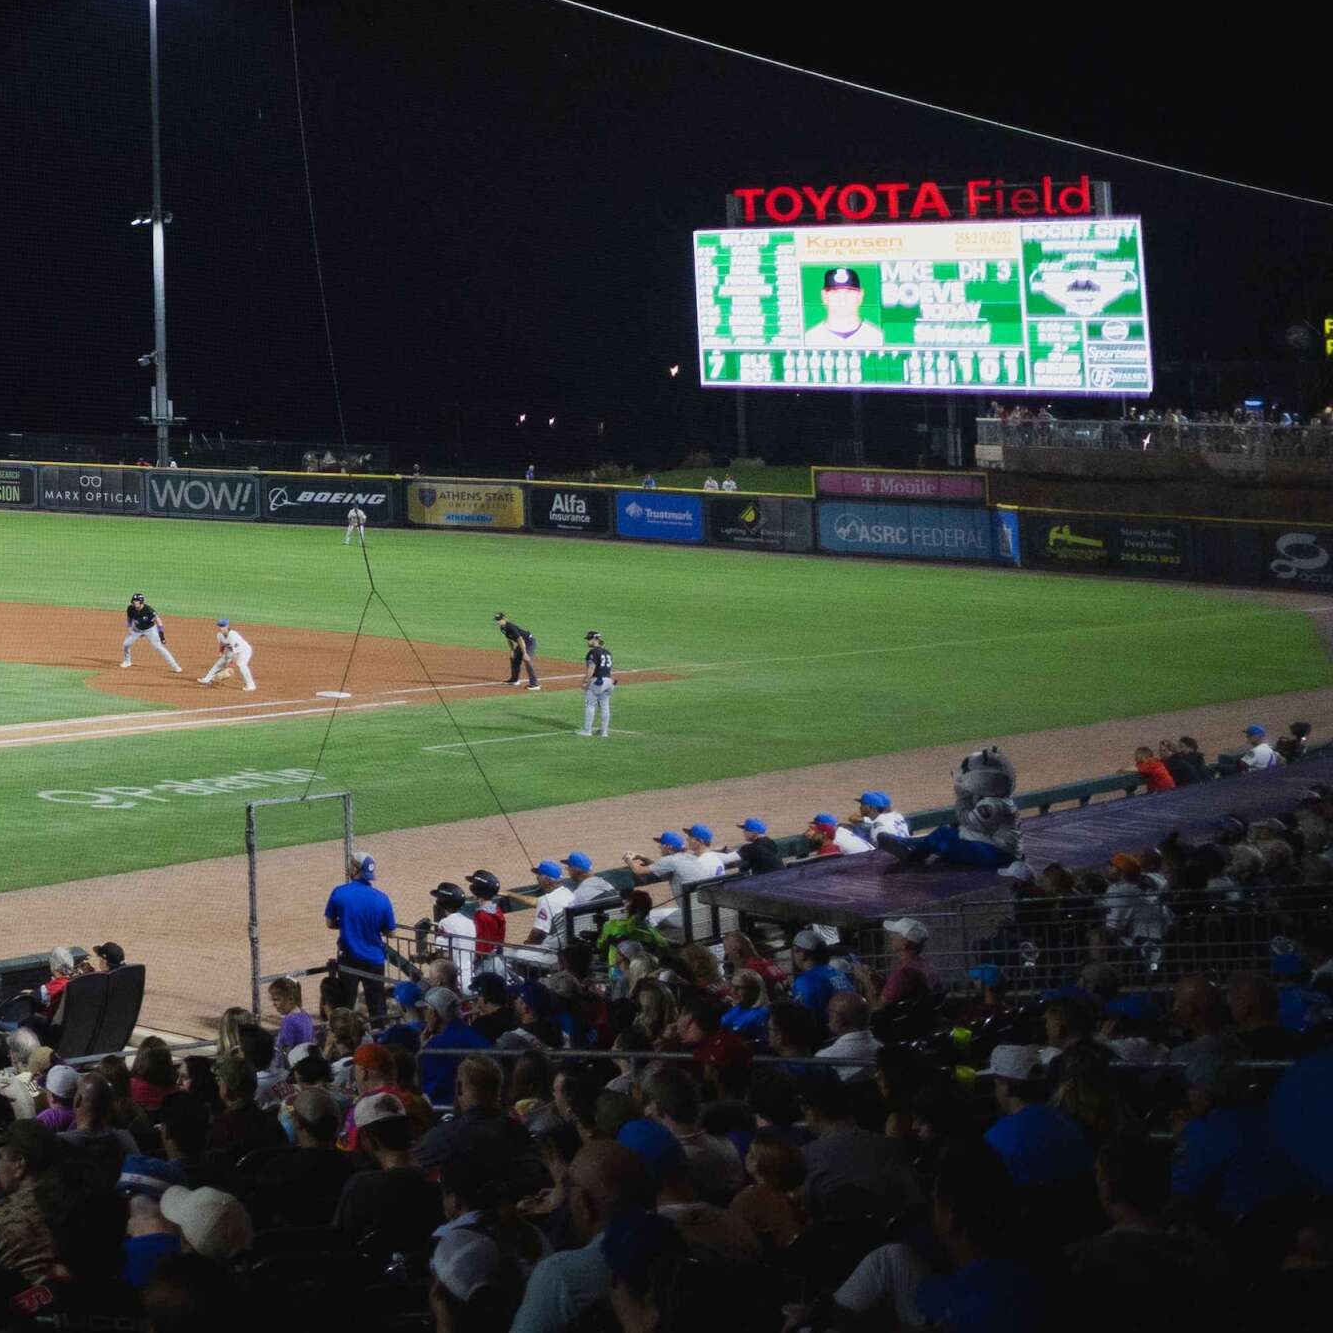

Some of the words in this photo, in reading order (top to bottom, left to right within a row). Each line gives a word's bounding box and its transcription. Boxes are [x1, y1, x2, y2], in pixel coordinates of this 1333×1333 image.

[735, 182, 950, 221] TOYOTA
[968, 175, 1091, 217] Field
[805, 234, 903, 248] Koorsen
[881, 262, 934, 281] MIKE
[959, 262, 988, 282] DH
[881, 282, 966, 306] BOEVE
[708, 355, 725, 379] 7
[880, 478, 936, 494] Mobile
[45, 490, 80, 501] MARX
[85, 491, 140, 504] OPTICAL
[151, 480, 254, 511] WOW!
[297, 491, 387, 505] BOEING
[439, 491, 482, 501] ATHENS
[485, 492, 517, 503] STATE
[552, 493, 587, 514] Alfa
[549, 510, 591, 524] Insurance
[645, 508, 694, 522] Trustmark
[859, 525, 909, 544] ASRC
[912, 527, 987, 548] FEDERAL
